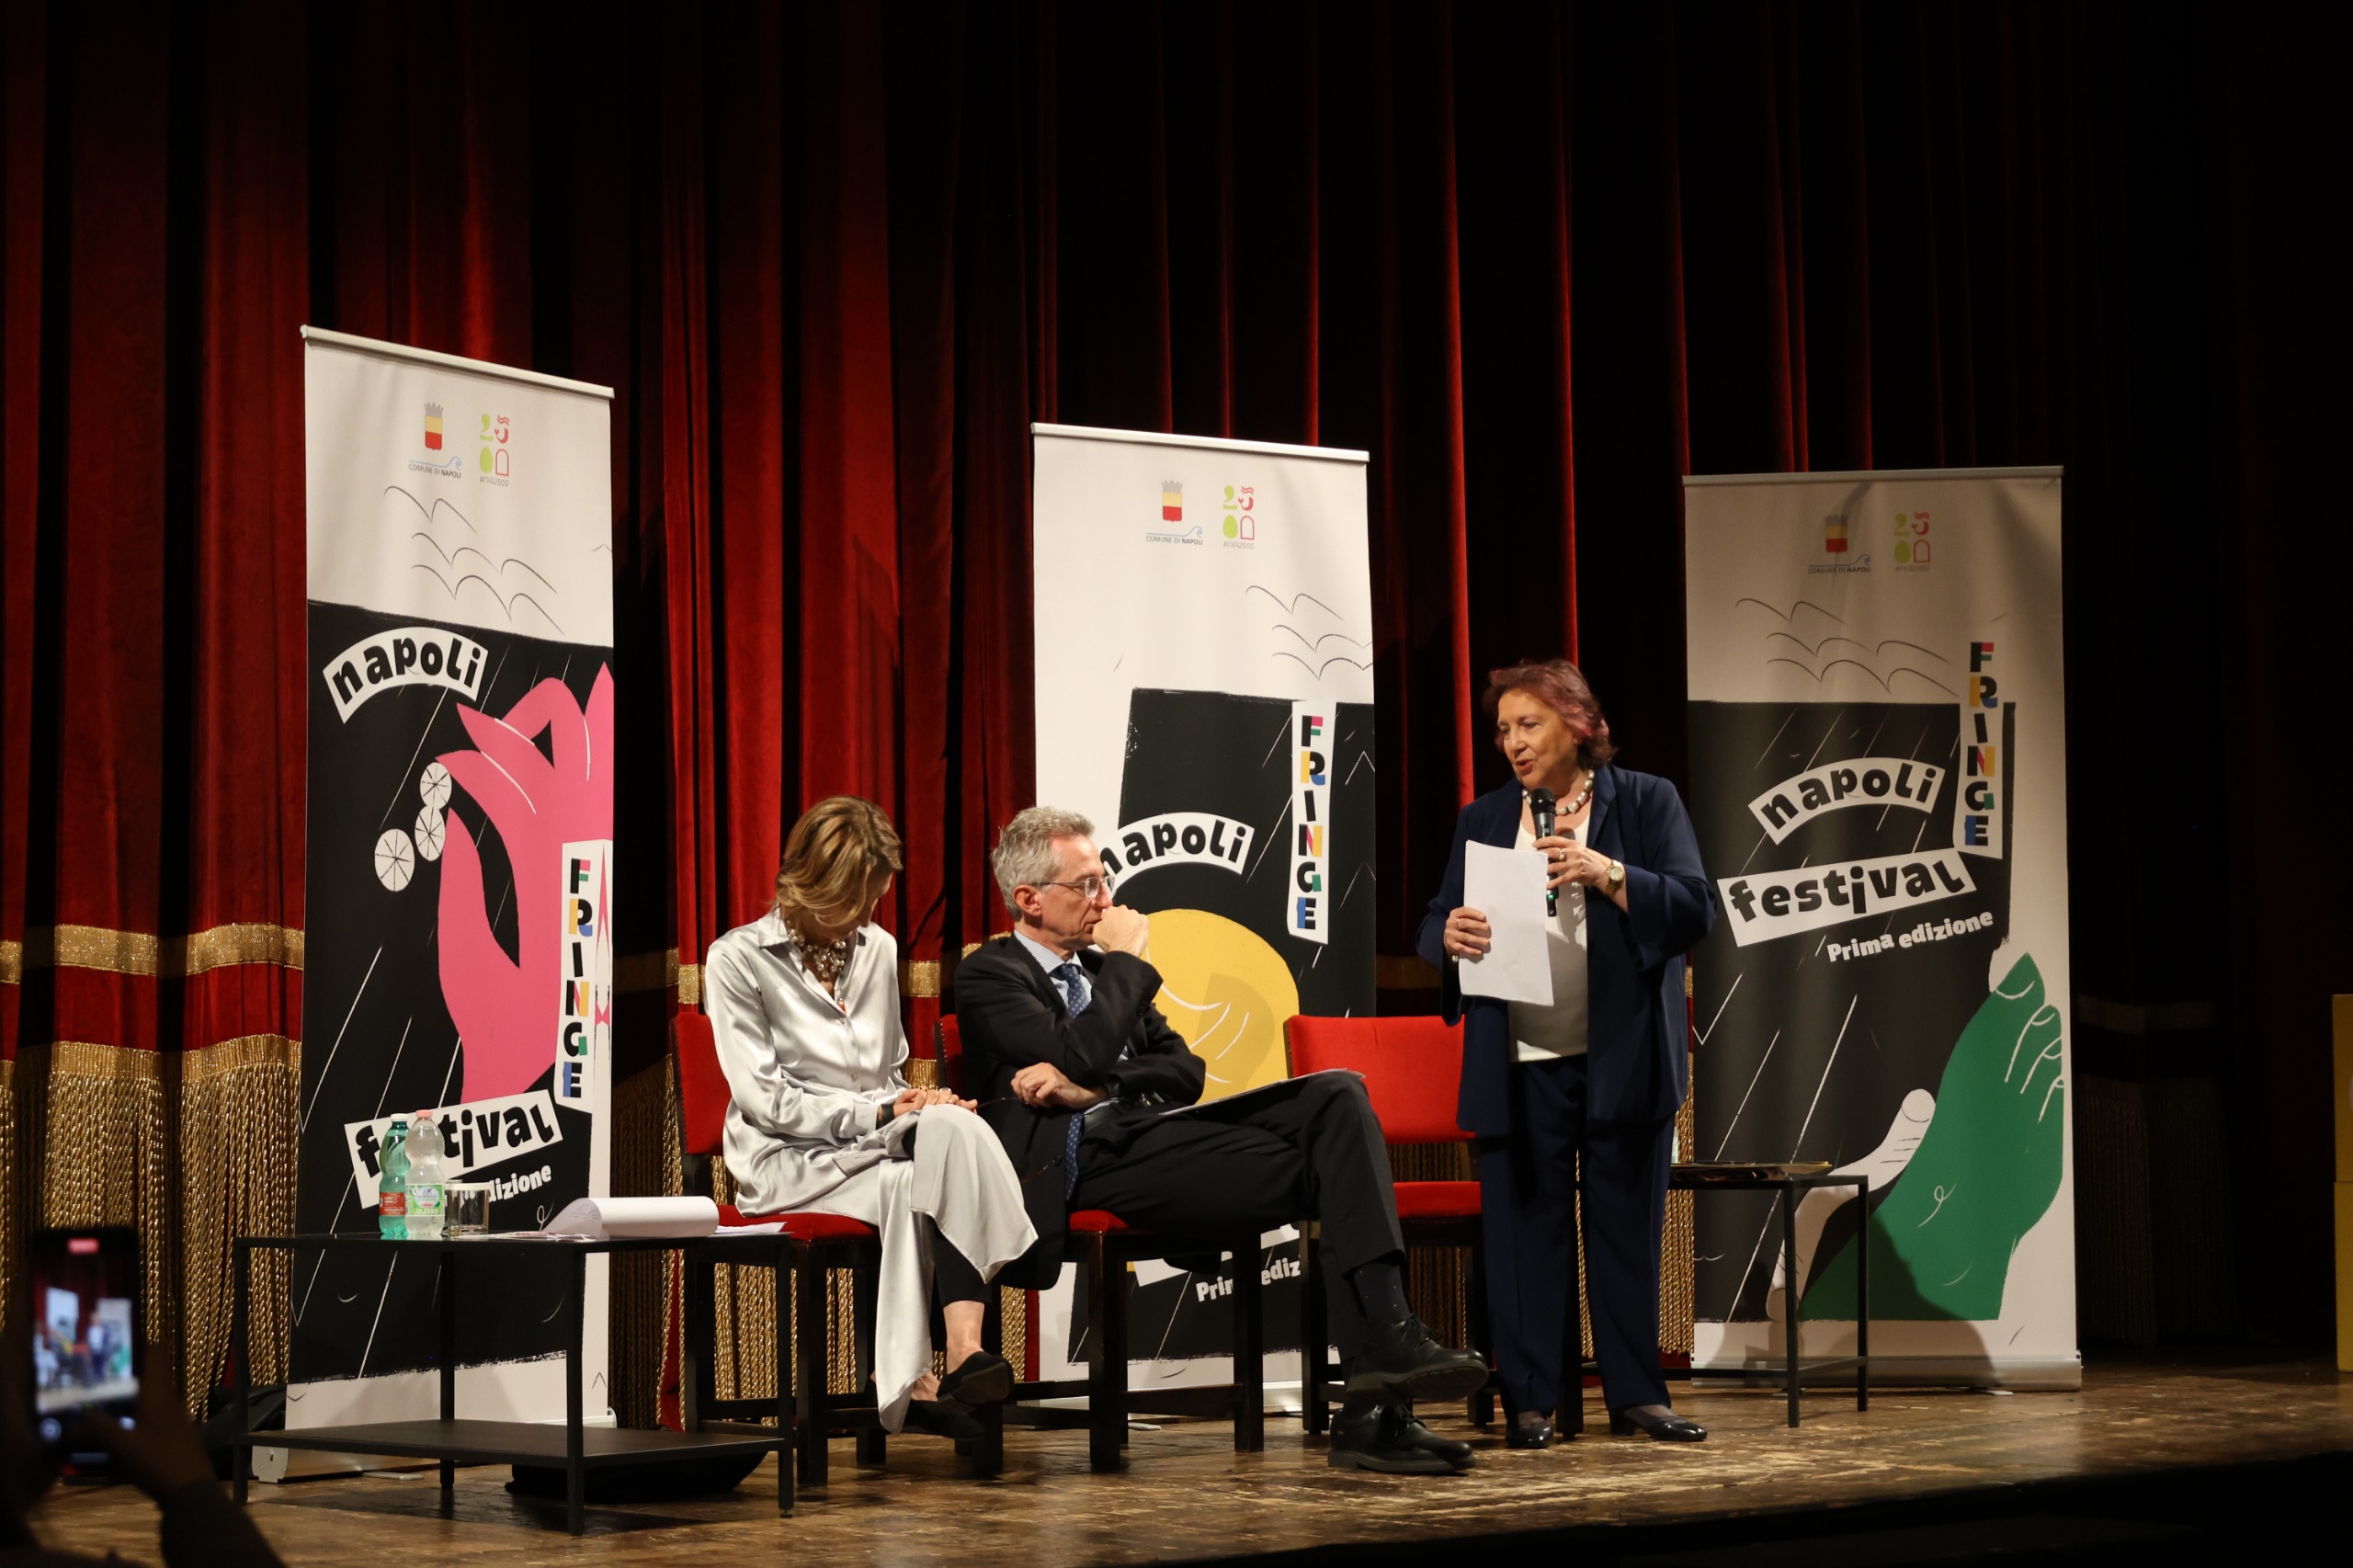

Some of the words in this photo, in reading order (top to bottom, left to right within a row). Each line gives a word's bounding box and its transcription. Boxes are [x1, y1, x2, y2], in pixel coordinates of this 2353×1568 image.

[408, 462, 434, 474] COMUNE
[434, 466, 440, 475] DI
[441, 469, 461, 479] NAPOLI
[1145, 535, 1173, 544] COMUNE
[1181, 538, 1203, 546] NAPOLI
[332, 636, 481, 706] napoli
[1964, 642, 1998, 846] FRINGE
[1296, 714, 1326, 930] FRINGE
[1760, 762, 1937, 831] napoli
[1728, 859, 1966, 923] festival
[1826, 933, 1895, 962] Prima
[1898, 911, 1994, 949] edizione
[563, 858, 593, 1098] FRINGE
[355, 1104, 555, 1178] ftival
